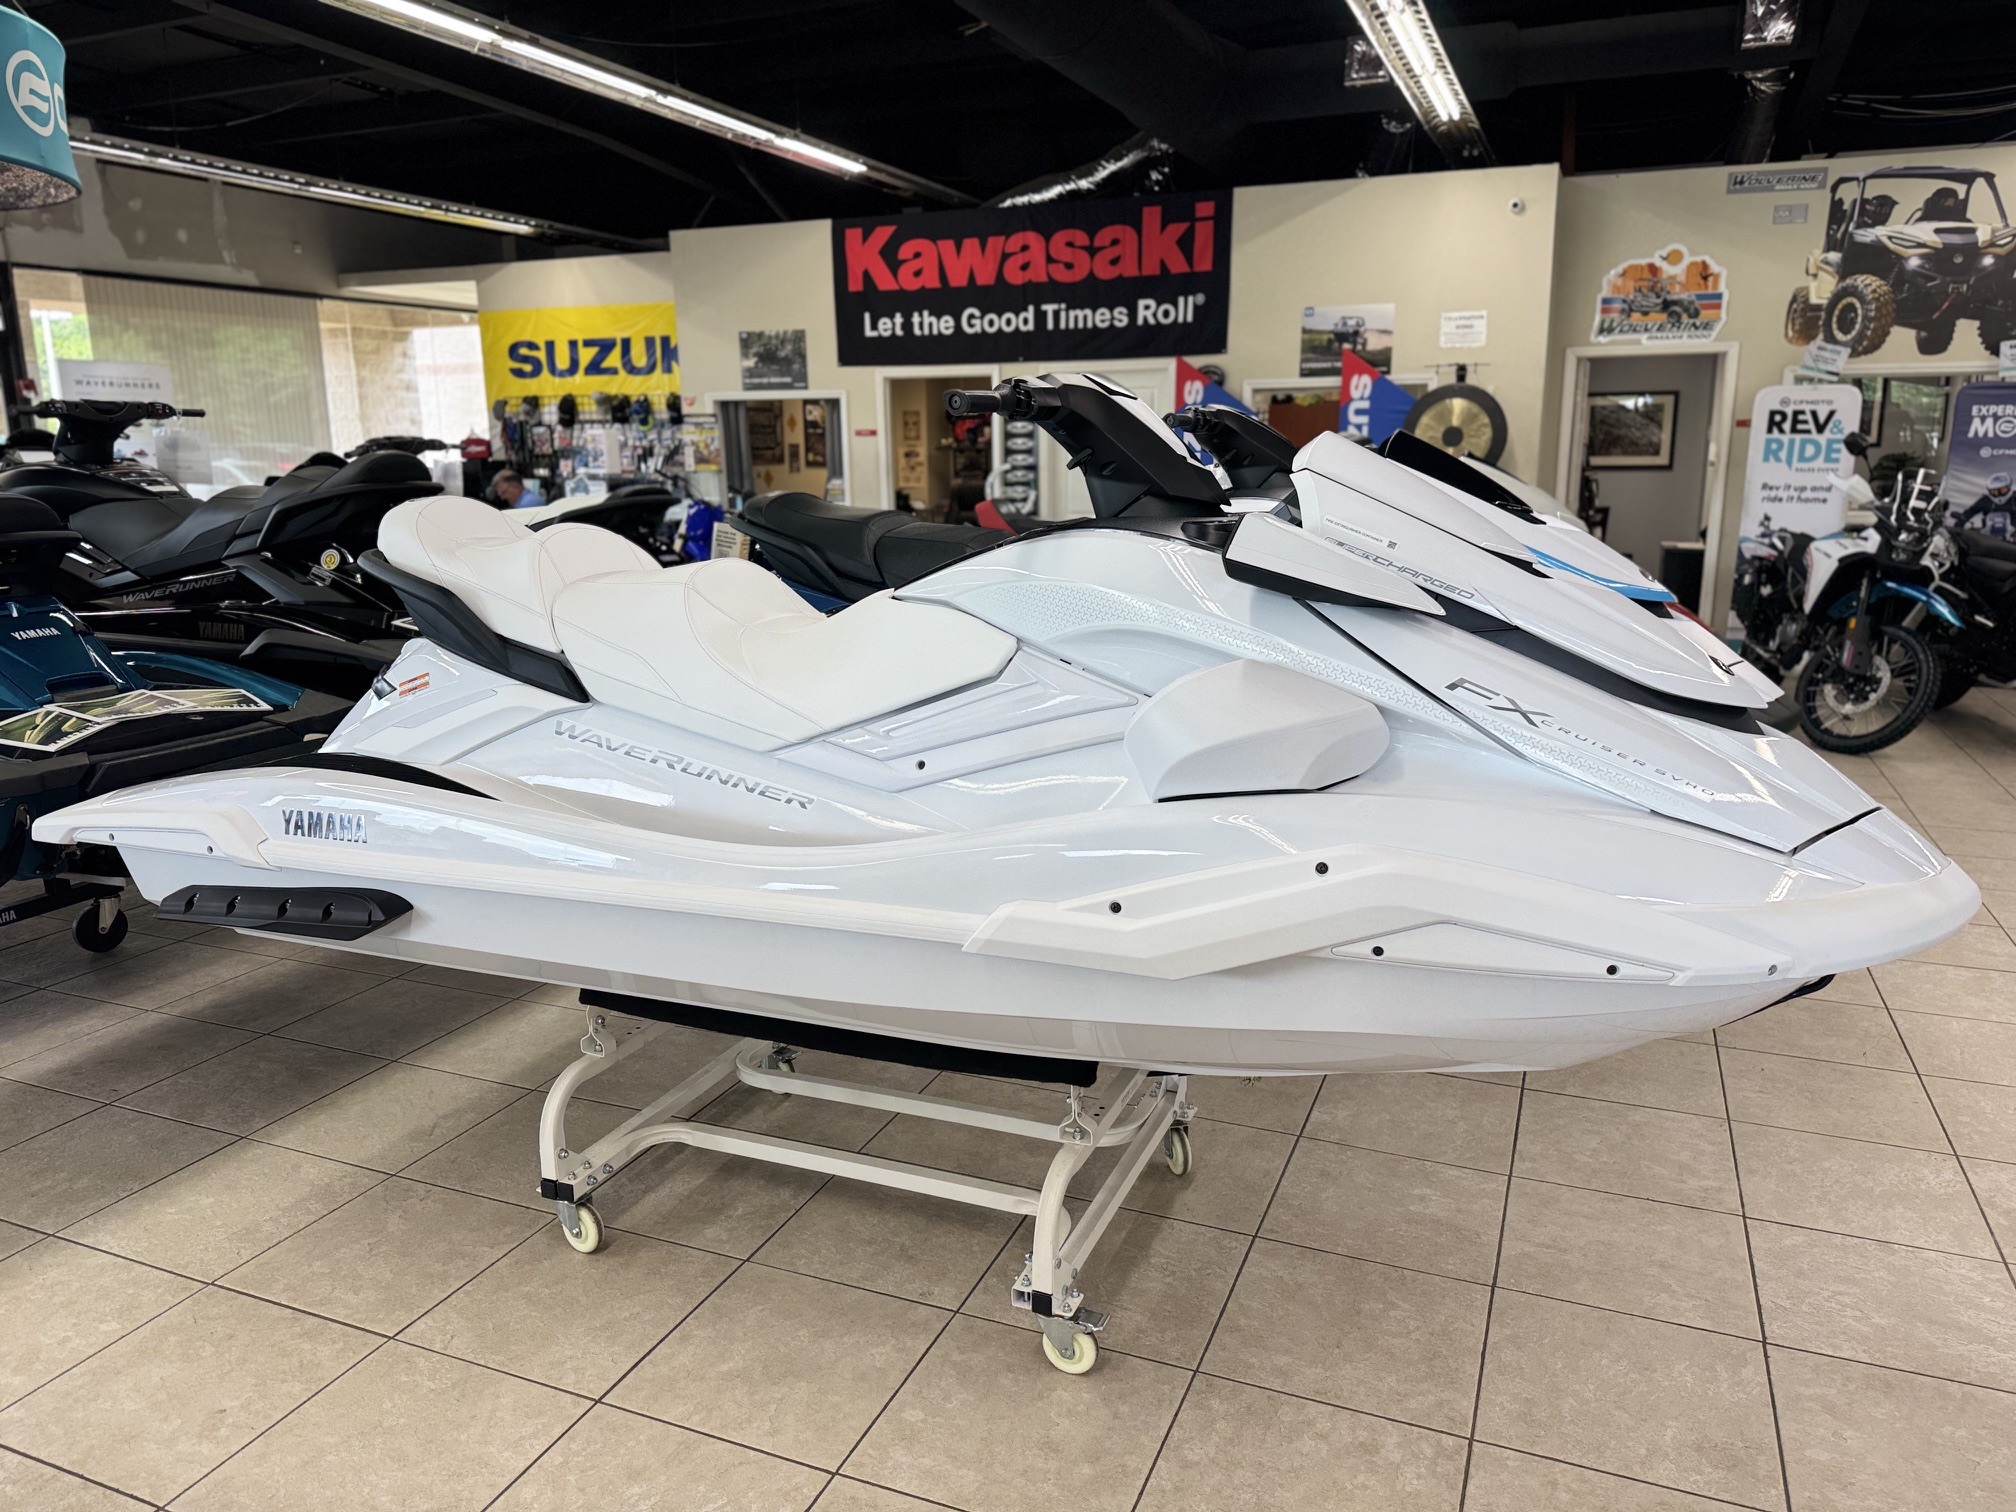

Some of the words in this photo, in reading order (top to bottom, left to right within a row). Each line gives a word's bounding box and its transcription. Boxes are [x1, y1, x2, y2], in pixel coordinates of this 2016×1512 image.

[845, 201, 1215, 293] Kawasaki
[864, 311, 904, 338] Let
[912, 310, 956, 336] the
[961, 304, 1035, 334] Good
[1041, 303, 1129, 331] Times
[1597, 318, 1718, 338] WOLVERINE
[74, 378, 161, 390] WAVERUNNERS
[1762, 437, 1844, 471] RIDE
[1761, 482, 1781, 492] Rev
[1783, 483, 1791, 492] it
[1794, 485, 1808, 494] up
[1810, 484, 1833, 492] and
[1761, 494, 1784, 503] ride
[1786, 495, 1794, 503] it
[1796, 494, 1828, 503] home
[10, 627, 61, 641] YAMAHA
[199, 621, 245, 641] YAMAHA
[1444, 677, 1555, 729] FX
[1541, 719, 1647, 767] CRUISER
[1654, 768, 1716, 797] SVHO
[281, 807, 368, 844] YAMAHA
